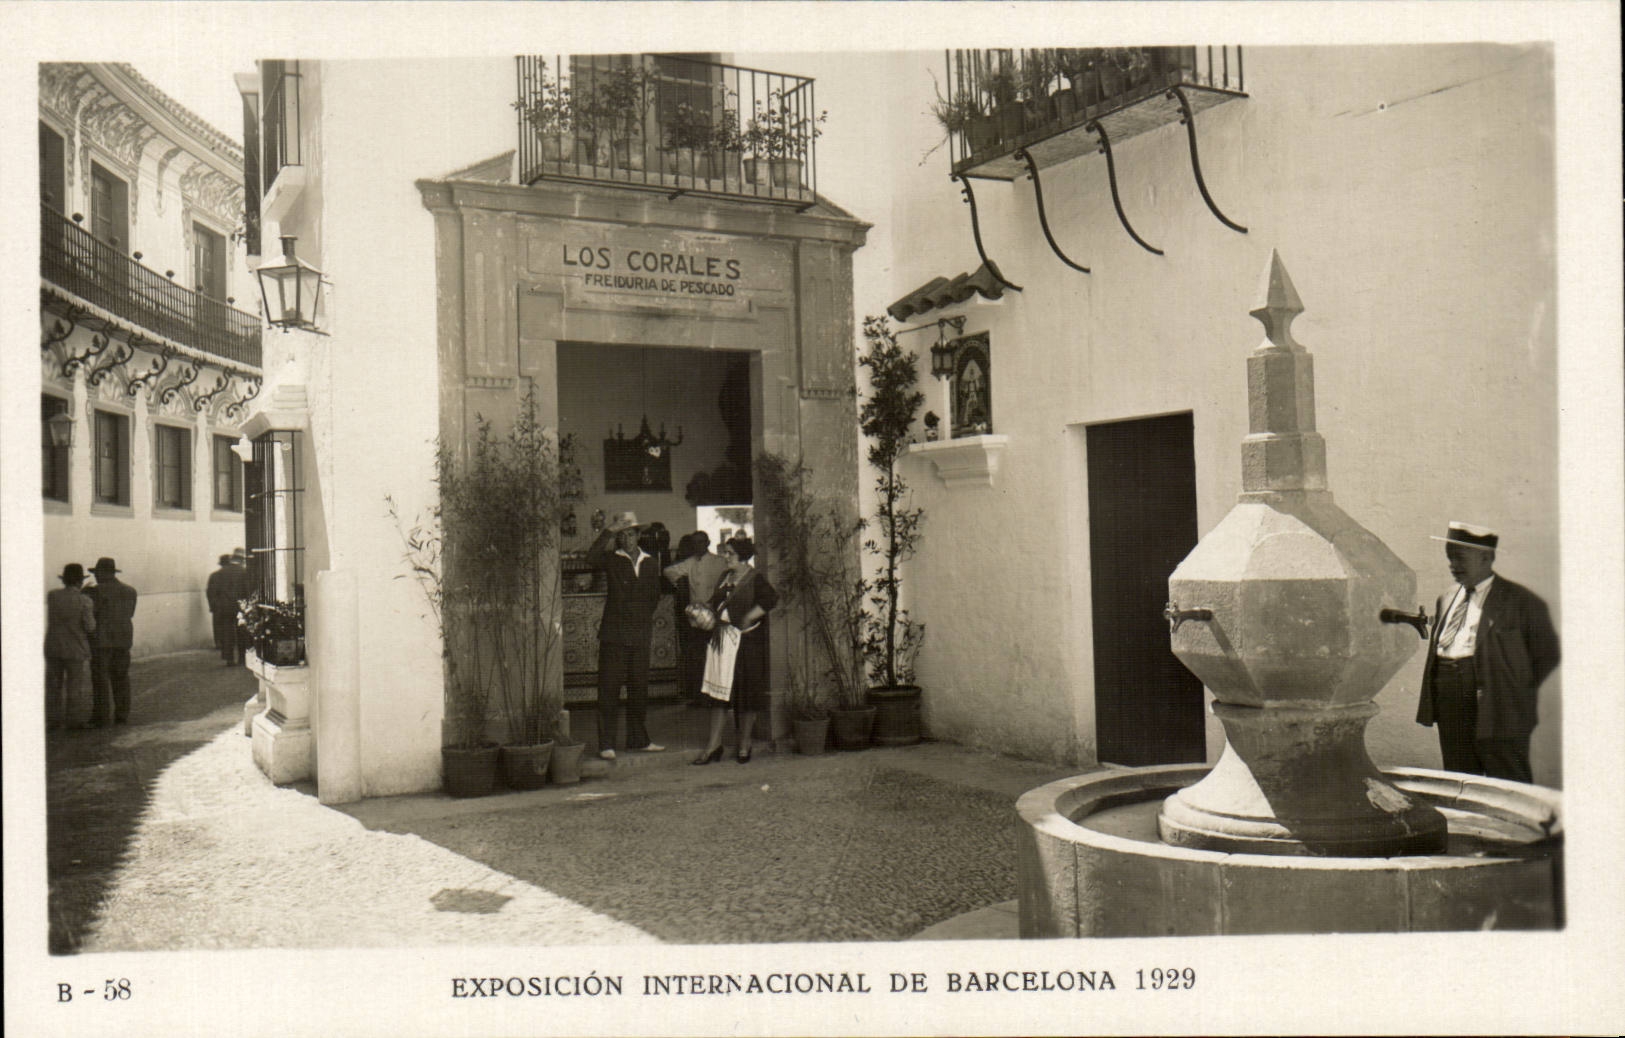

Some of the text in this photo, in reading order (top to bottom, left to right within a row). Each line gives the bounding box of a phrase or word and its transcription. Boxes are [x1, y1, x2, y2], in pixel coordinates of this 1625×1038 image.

[563, 244, 741, 280] LOS CORALES
[584, 273, 735, 297] FREIDURIA DE PESCADO
